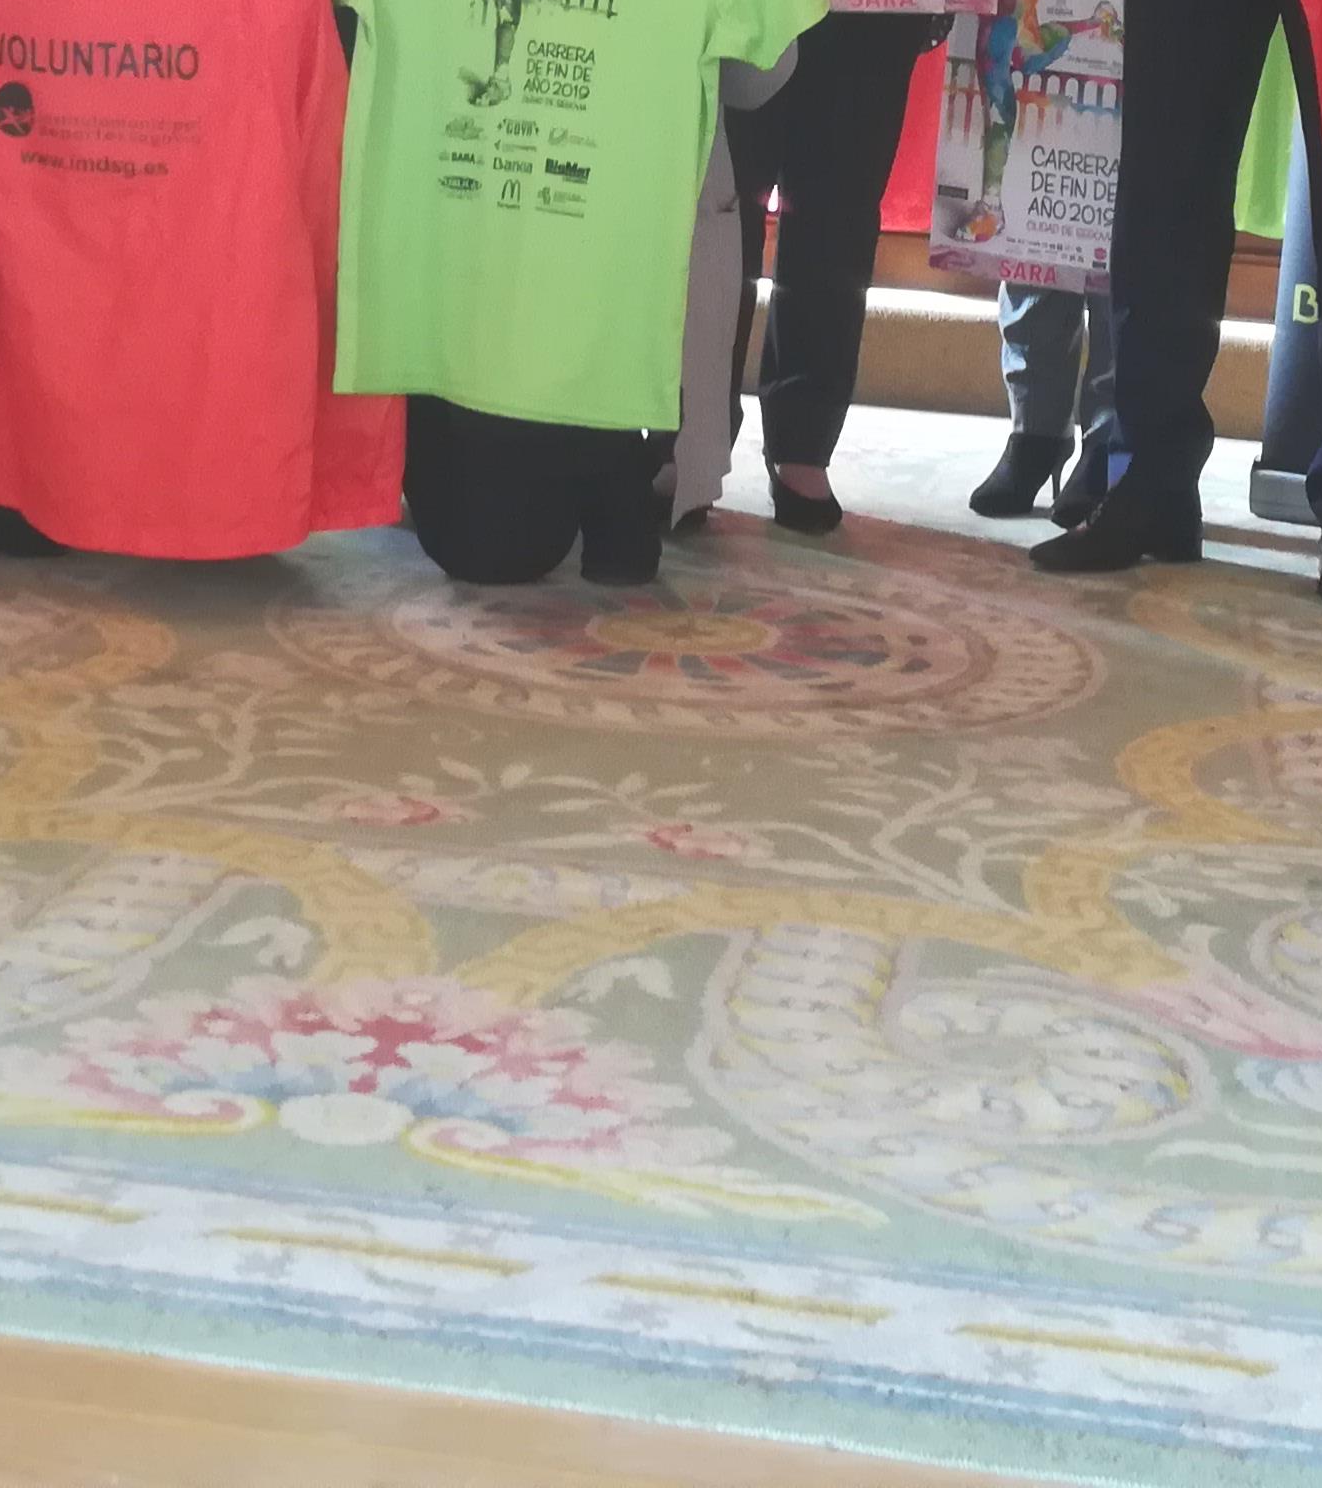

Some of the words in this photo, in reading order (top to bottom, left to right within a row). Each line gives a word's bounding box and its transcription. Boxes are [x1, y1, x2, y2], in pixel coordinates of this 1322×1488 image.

[527, 39, 596, 66] CARRERA
[526, 58, 542, 76] DE
[546, 61, 568, 80] FIN
[572, 64, 592, 83] DE
[552, 81, 591, 100] 2019
[20, 150, 169, 180] www.imdsg.es
[1031, 144, 1120, 178] CARRERA
[1031, 171, 1055, 195] DE
[1060, 175, 1087, 200] FIN
[1093, 178, 1117, 204] DE
[1027, 195, 1066, 220] AÑO
[1069, 202, 1115, 228] 2019
[998, 260, 1058, 285] SARA
